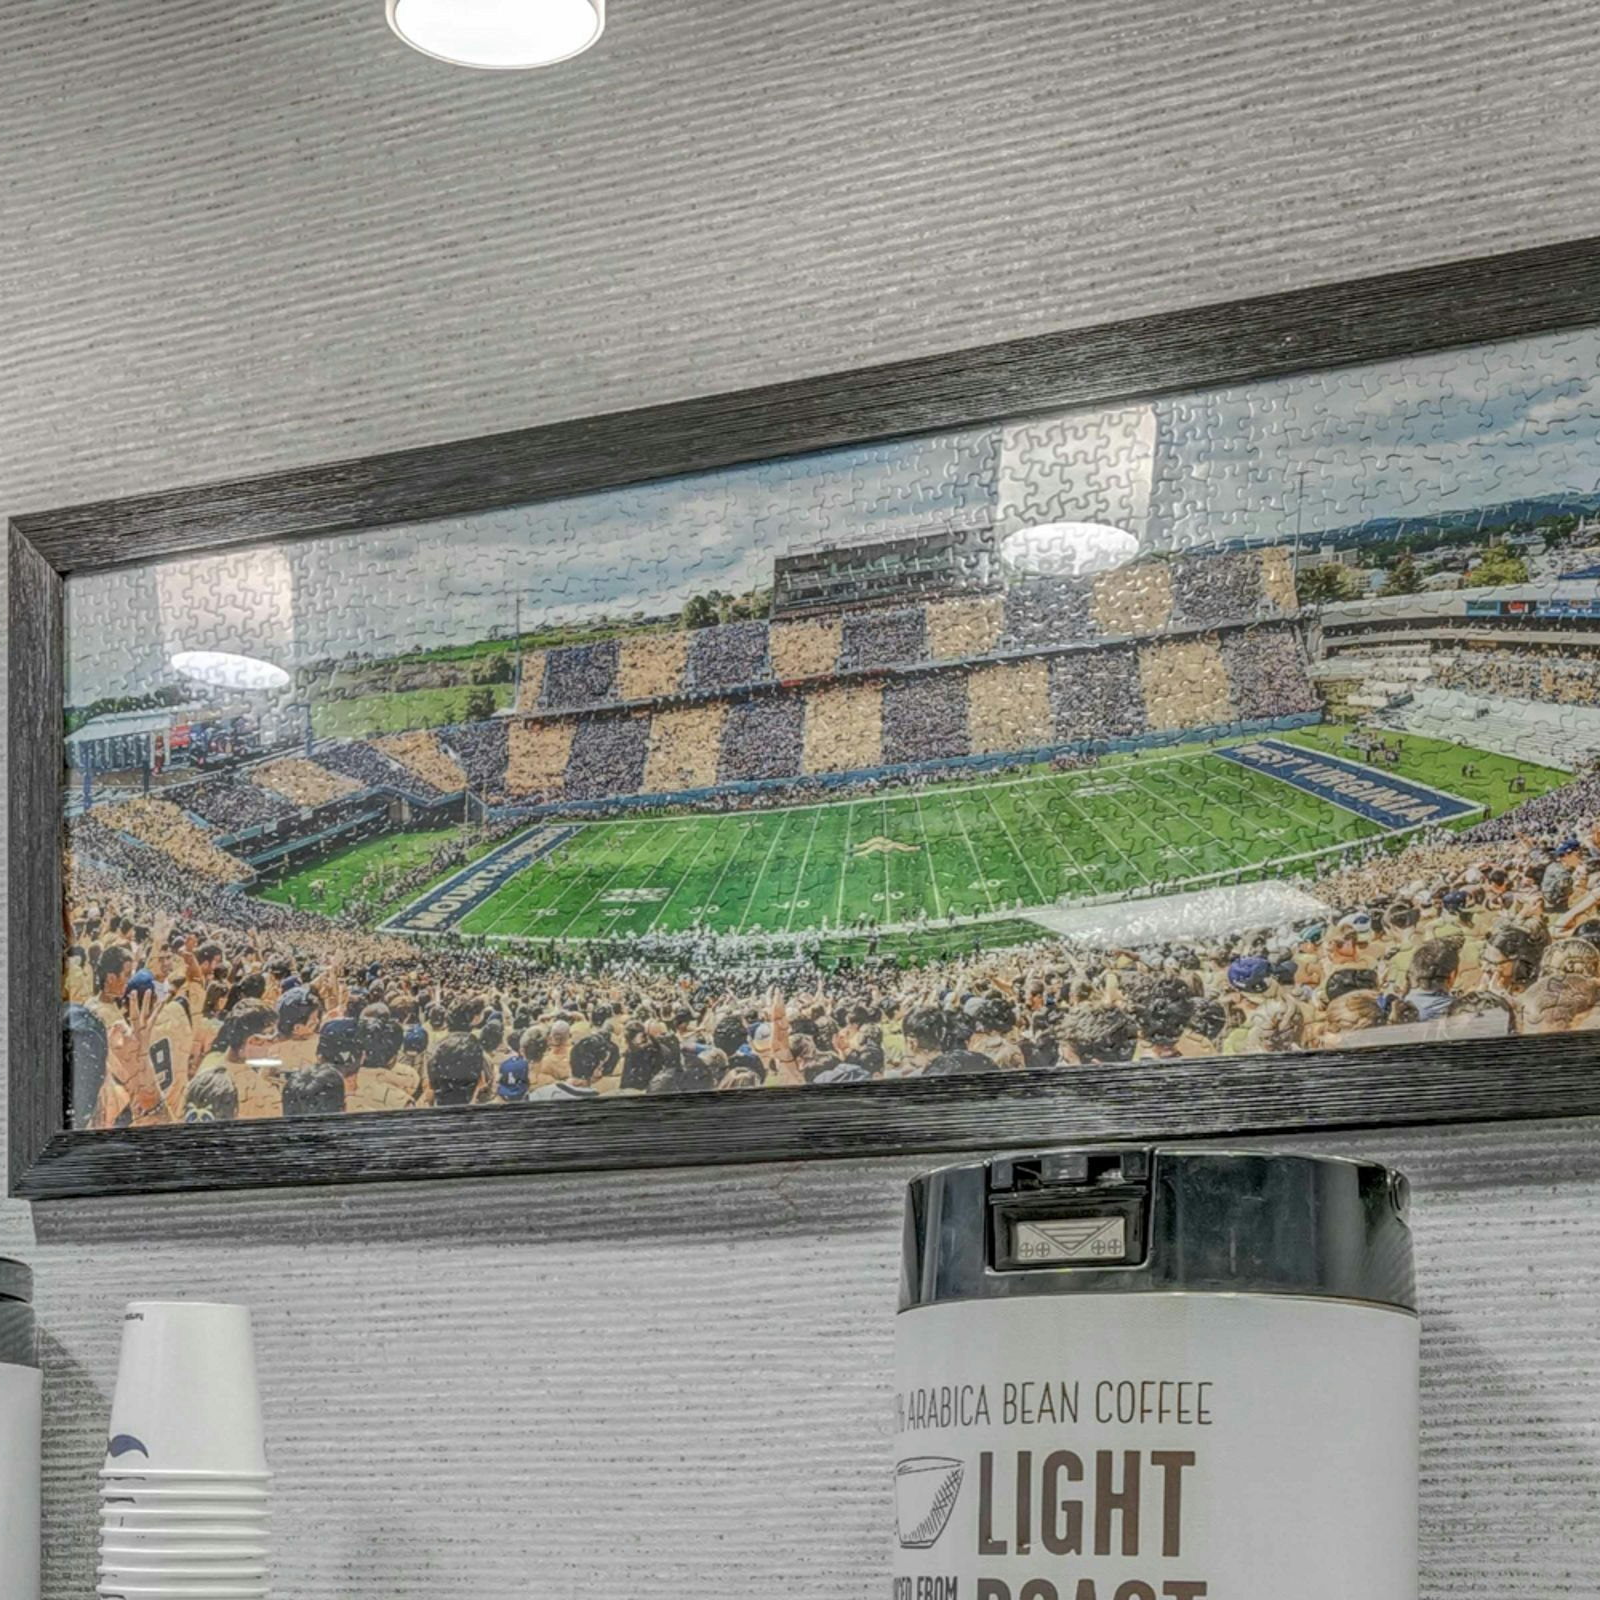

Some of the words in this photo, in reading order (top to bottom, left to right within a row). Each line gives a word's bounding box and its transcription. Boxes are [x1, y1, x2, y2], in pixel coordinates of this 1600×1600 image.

[906, 1384, 992, 1432] ARABICA
[1002, 1380, 1080, 1425] BEAN
[1095, 1380, 1214, 1425] COFFEE
[977, 1449, 1197, 1557] LIGHT
